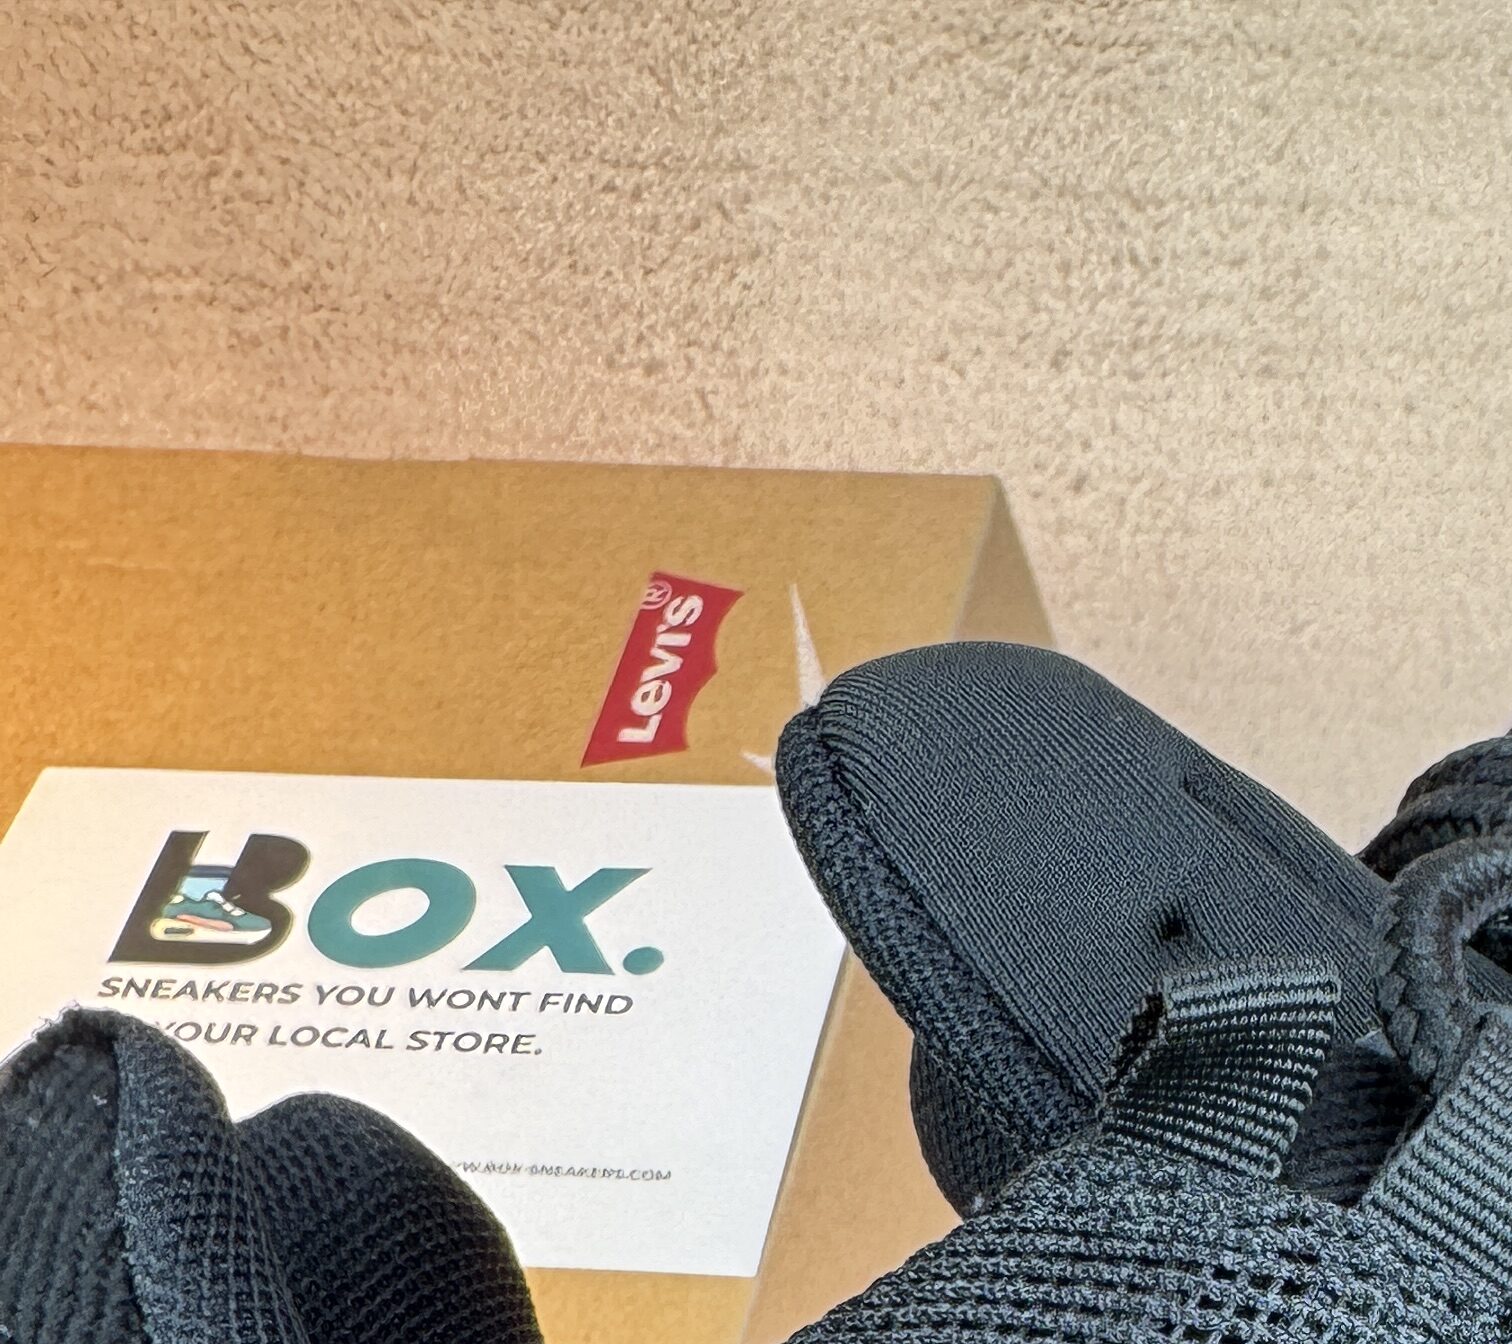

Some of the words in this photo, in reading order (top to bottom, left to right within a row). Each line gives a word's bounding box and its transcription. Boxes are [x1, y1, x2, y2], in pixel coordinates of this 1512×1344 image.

[98, 977, 303, 1005] SNEAKERS
[316, 984, 396, 1008] YOU
[408, 987, 532, 1012] WONT
[538, 992, 634, 1015] FIND
[268, 1024, 394, 1050] LOCAL
[406, 1030, 543, 1055] STORE.
